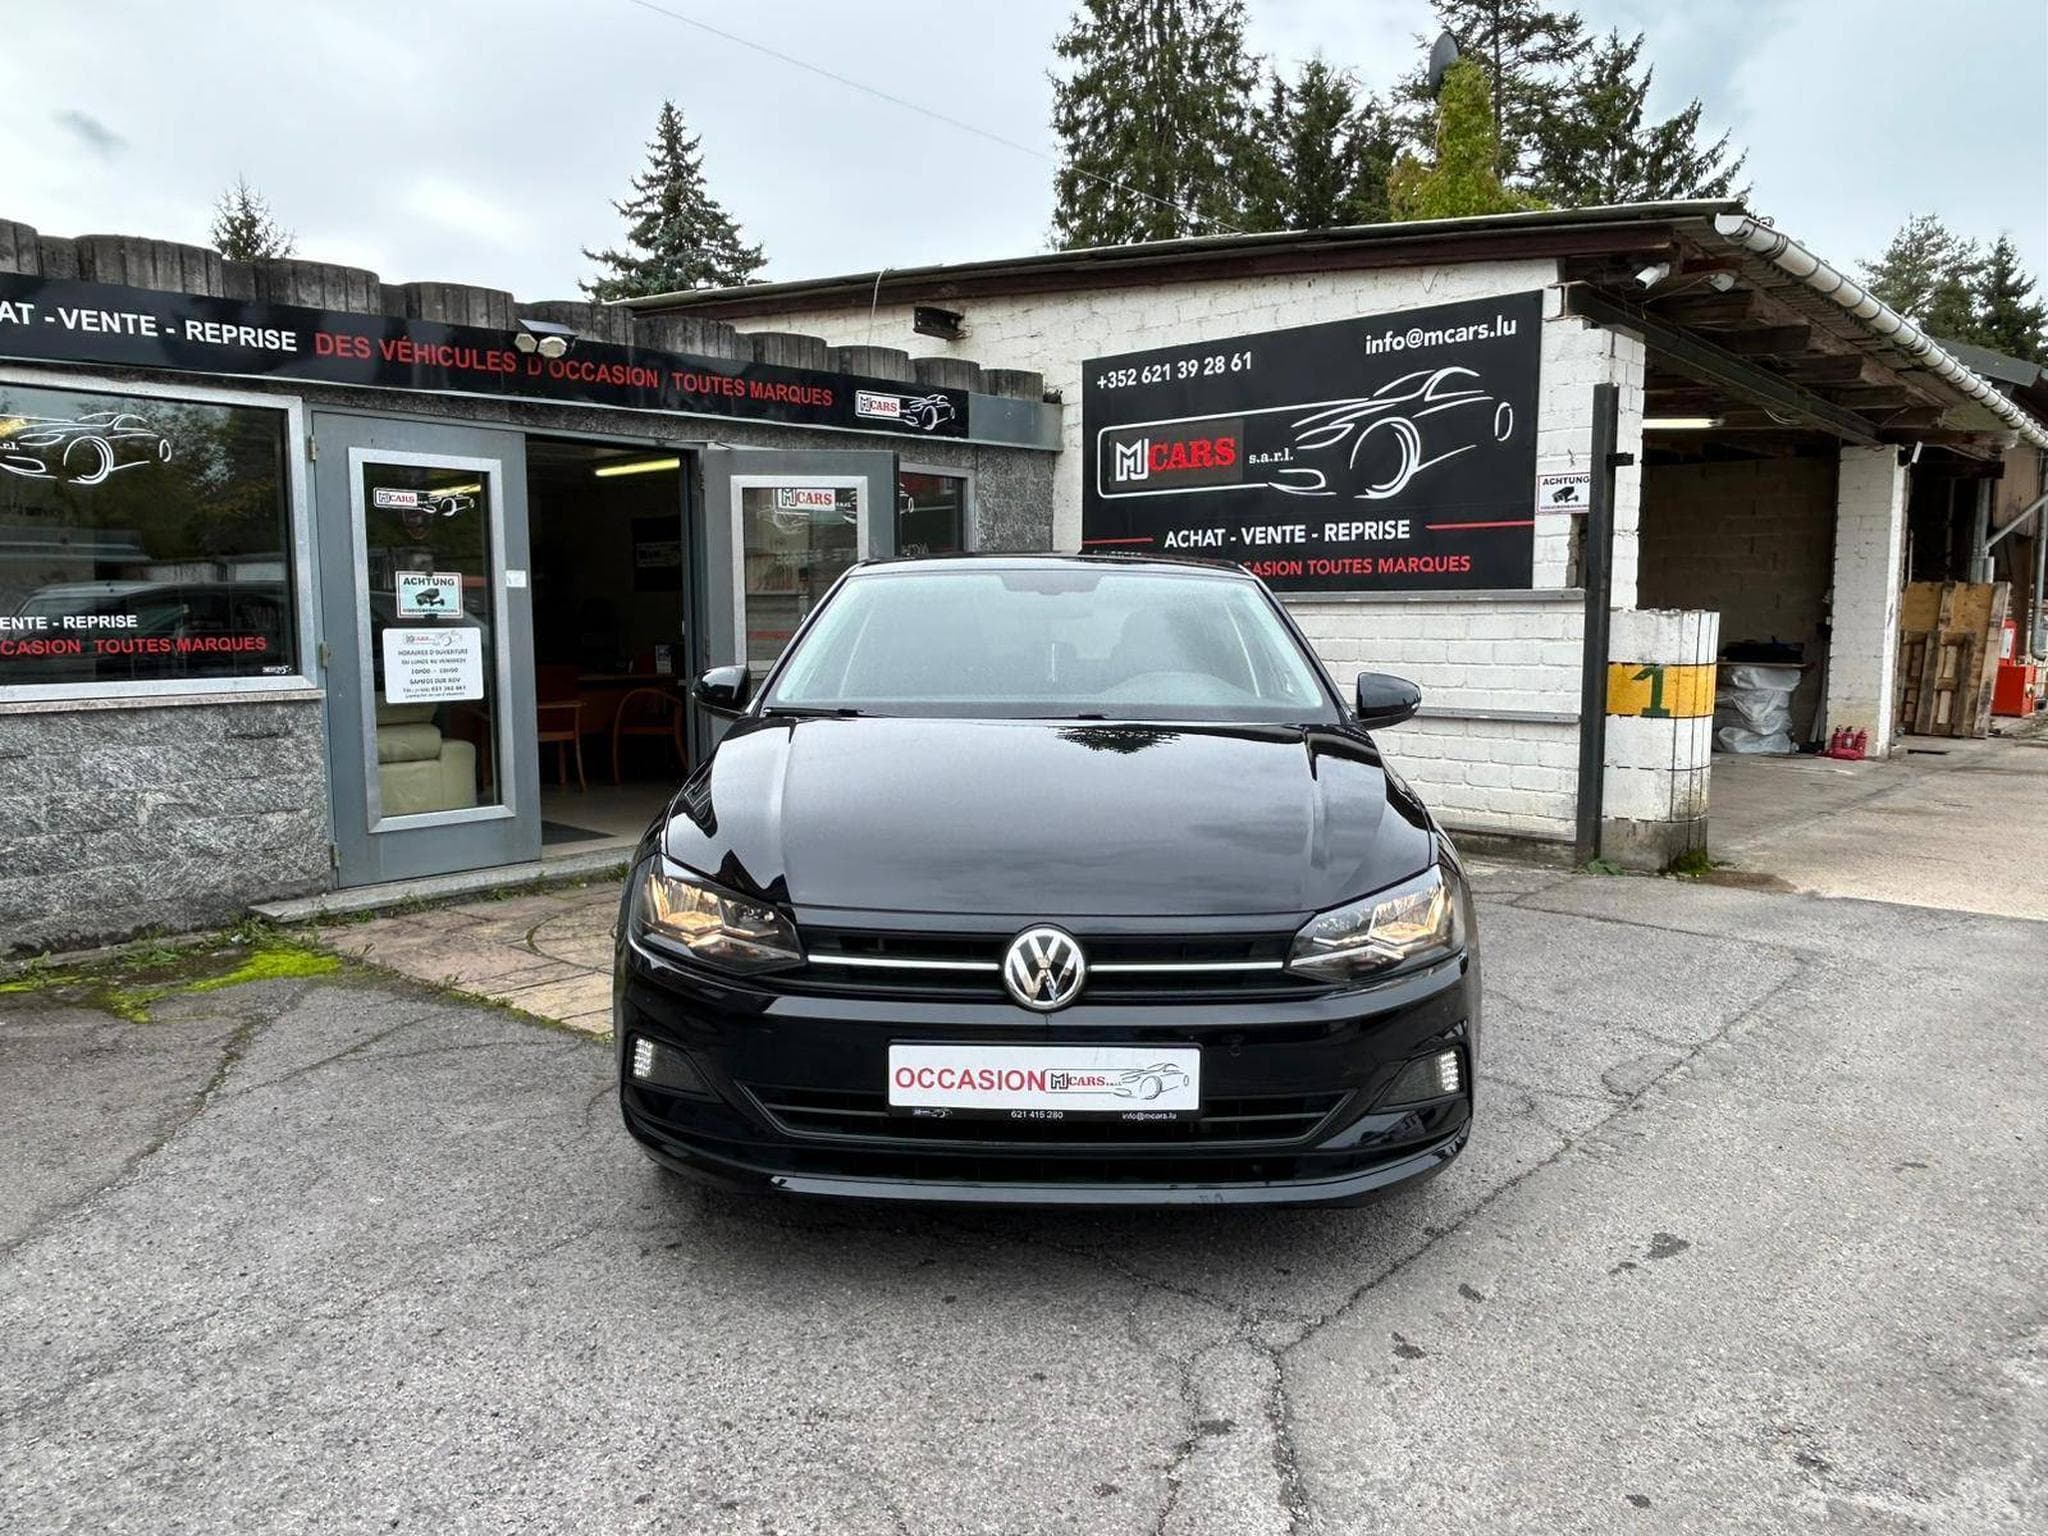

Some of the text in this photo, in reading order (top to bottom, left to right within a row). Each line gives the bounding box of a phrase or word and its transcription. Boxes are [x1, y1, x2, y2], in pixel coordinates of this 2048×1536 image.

[1365, 314, 1517, 355] info@mcars.lu
[57, 307, 159, 337] VENTE
[185, 319, 297, 352] REPRISE
[315, 332, 371, 359] DES
[378, 336, 516, 373] VÉHICULES
[526, 357, 658, 388] DOCCASION
[672, 371, 745, 397] TOUTES
[750, 380, 833, 407] MARQUES
[1097, 351, 1252, 389] +352 621 39 28 61
[1249, 447, 1294, 464] s.a.r.l.
[1543, 475, 1590, 485] ACHTUNG
[1164, 528, 1226, 548] ACHAT
[1240, 525, 1307, 545] VENTE
[1324, 520, 1410, 542] REPRISE
[1307, 558, 1373, 575] TOUTES
[1378, 556, 1471, 574] MARQUES
[403, 577, 455, 586] ACHTUNG
[63, 615, 138, 629] REPRISE
[94, 638, 171, 654] TOUTES
[177, 636, 268, 652] MARQUES
[1632, 664, 1671, 717] 1
[895, 1067, 1046, 1092] OCCASION
[1011, 1110, 1026, 1119] 621
